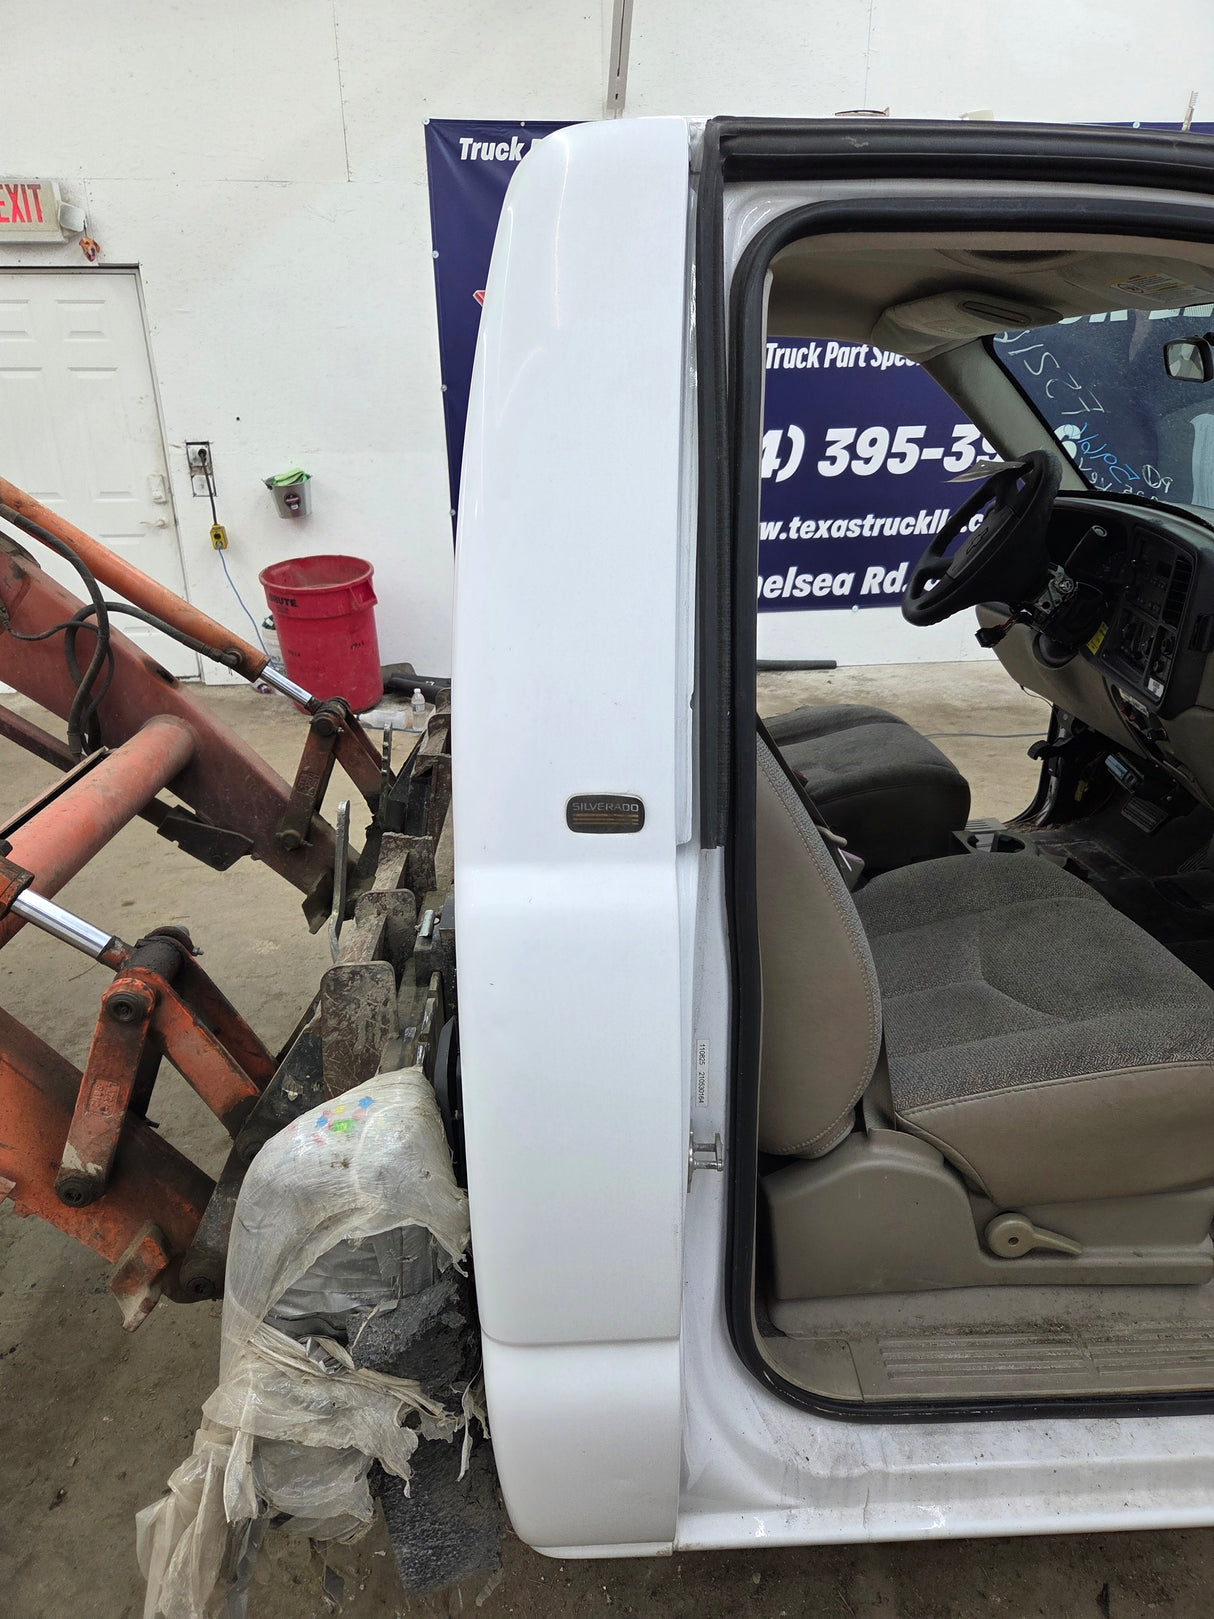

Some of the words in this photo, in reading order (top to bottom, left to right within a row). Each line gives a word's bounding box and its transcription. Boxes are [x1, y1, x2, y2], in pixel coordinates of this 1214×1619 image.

[459, 136, 525, 161] Truck
[765, 342, 822, 369] Truck
[823, 341, 869, 369] Part
[572, 801, 639, 812] SILVERADO
